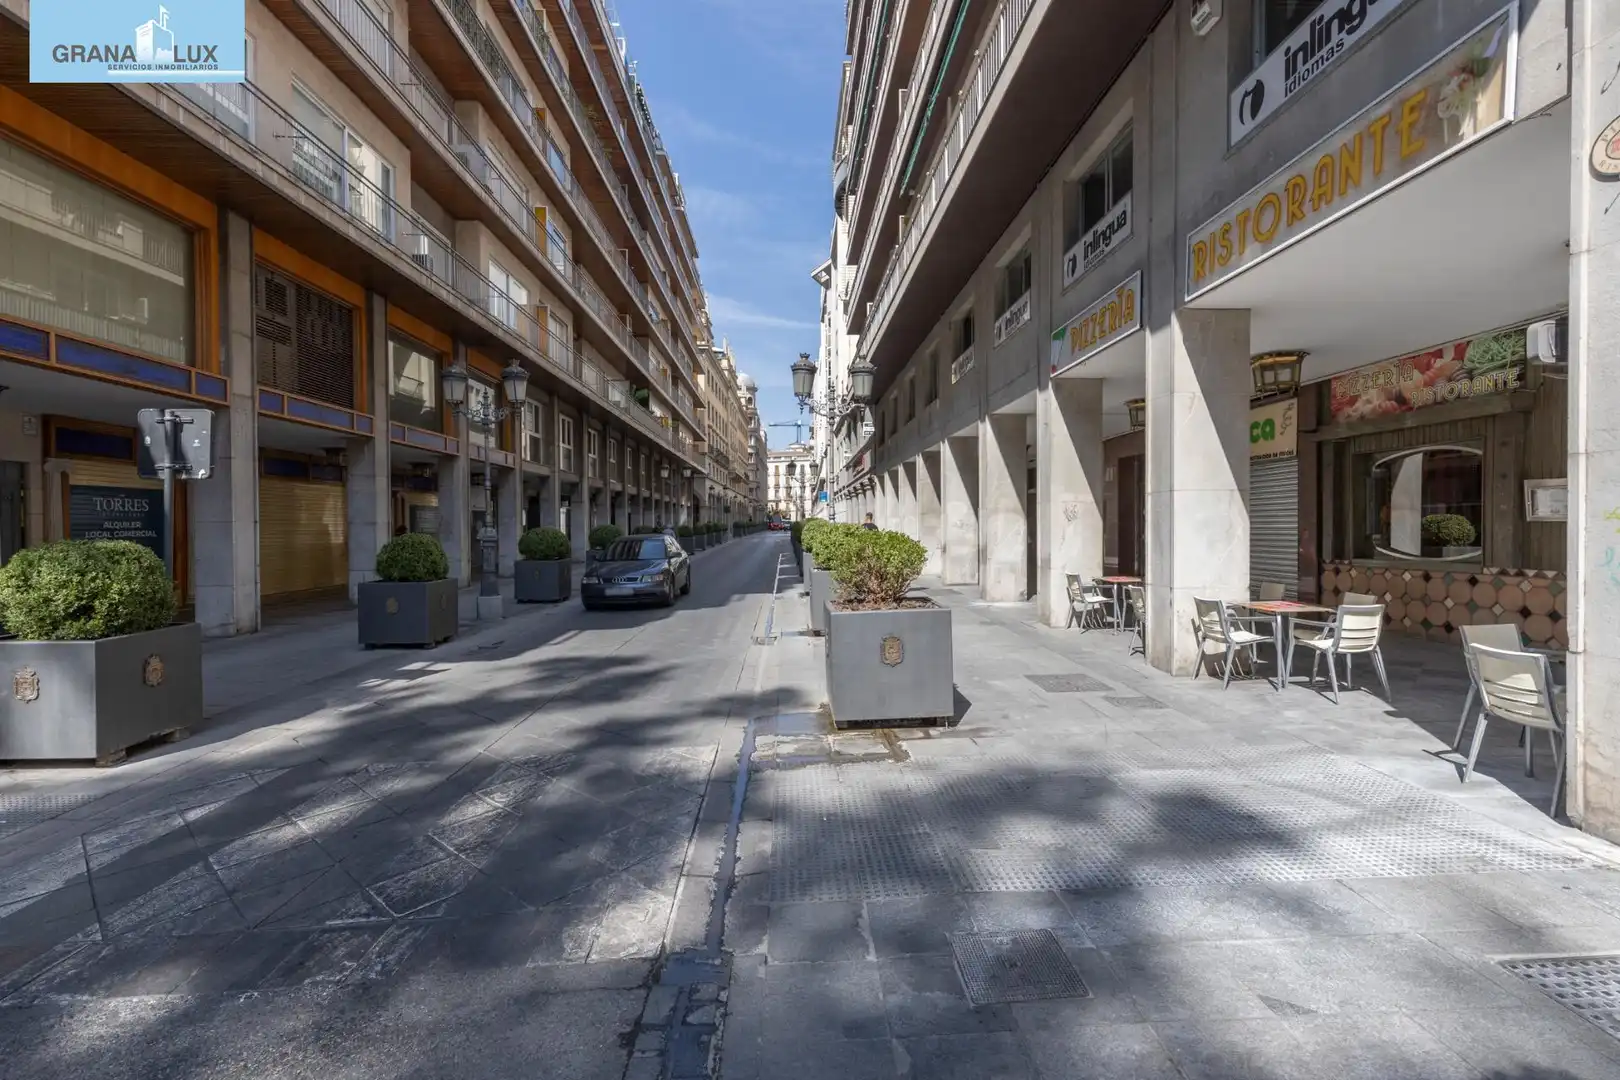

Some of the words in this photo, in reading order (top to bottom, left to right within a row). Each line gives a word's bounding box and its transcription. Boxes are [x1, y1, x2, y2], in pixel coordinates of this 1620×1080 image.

[1284, 0, 1378, 83] inling
[1284, 38, 1345, 98] idiomas
[1191, 86, 1428, 284] RISTORANTE
[1083, 208, 1127, 262] inlingua
[1411, 367, 1521, 408] RISTORANTE
[93, 496, 150, 512] TORRES
[103, 521, 142, 530] ALQUILER
[85, 531, 112, 539] LOCAL
[114, 530, 157, 538] COMERCIAL
